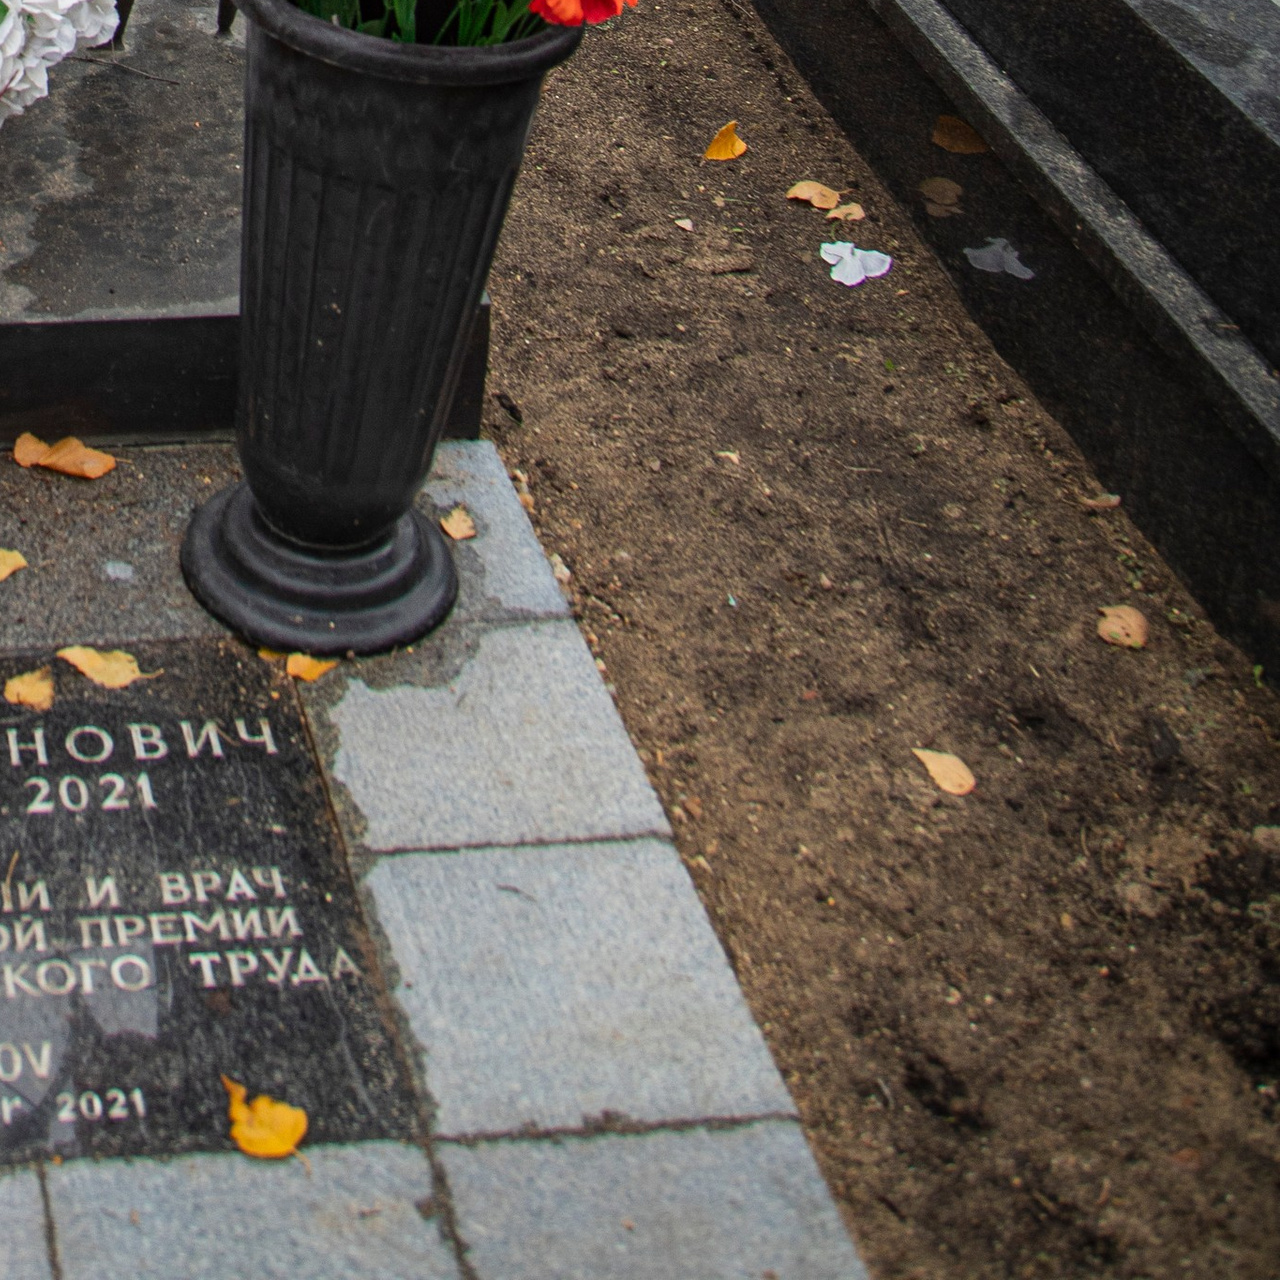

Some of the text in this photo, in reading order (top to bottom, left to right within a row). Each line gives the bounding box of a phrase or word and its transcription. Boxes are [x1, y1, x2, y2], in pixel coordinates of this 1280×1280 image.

[86, 877, 121, 908] И
[160, 867, 287, 906] ВРАЧ
[79, 907, 303, 949] ПРЕМИИ
[189, 948, 363, 988] ТРУДА
[57, 1088, 147, 1123] 2021
